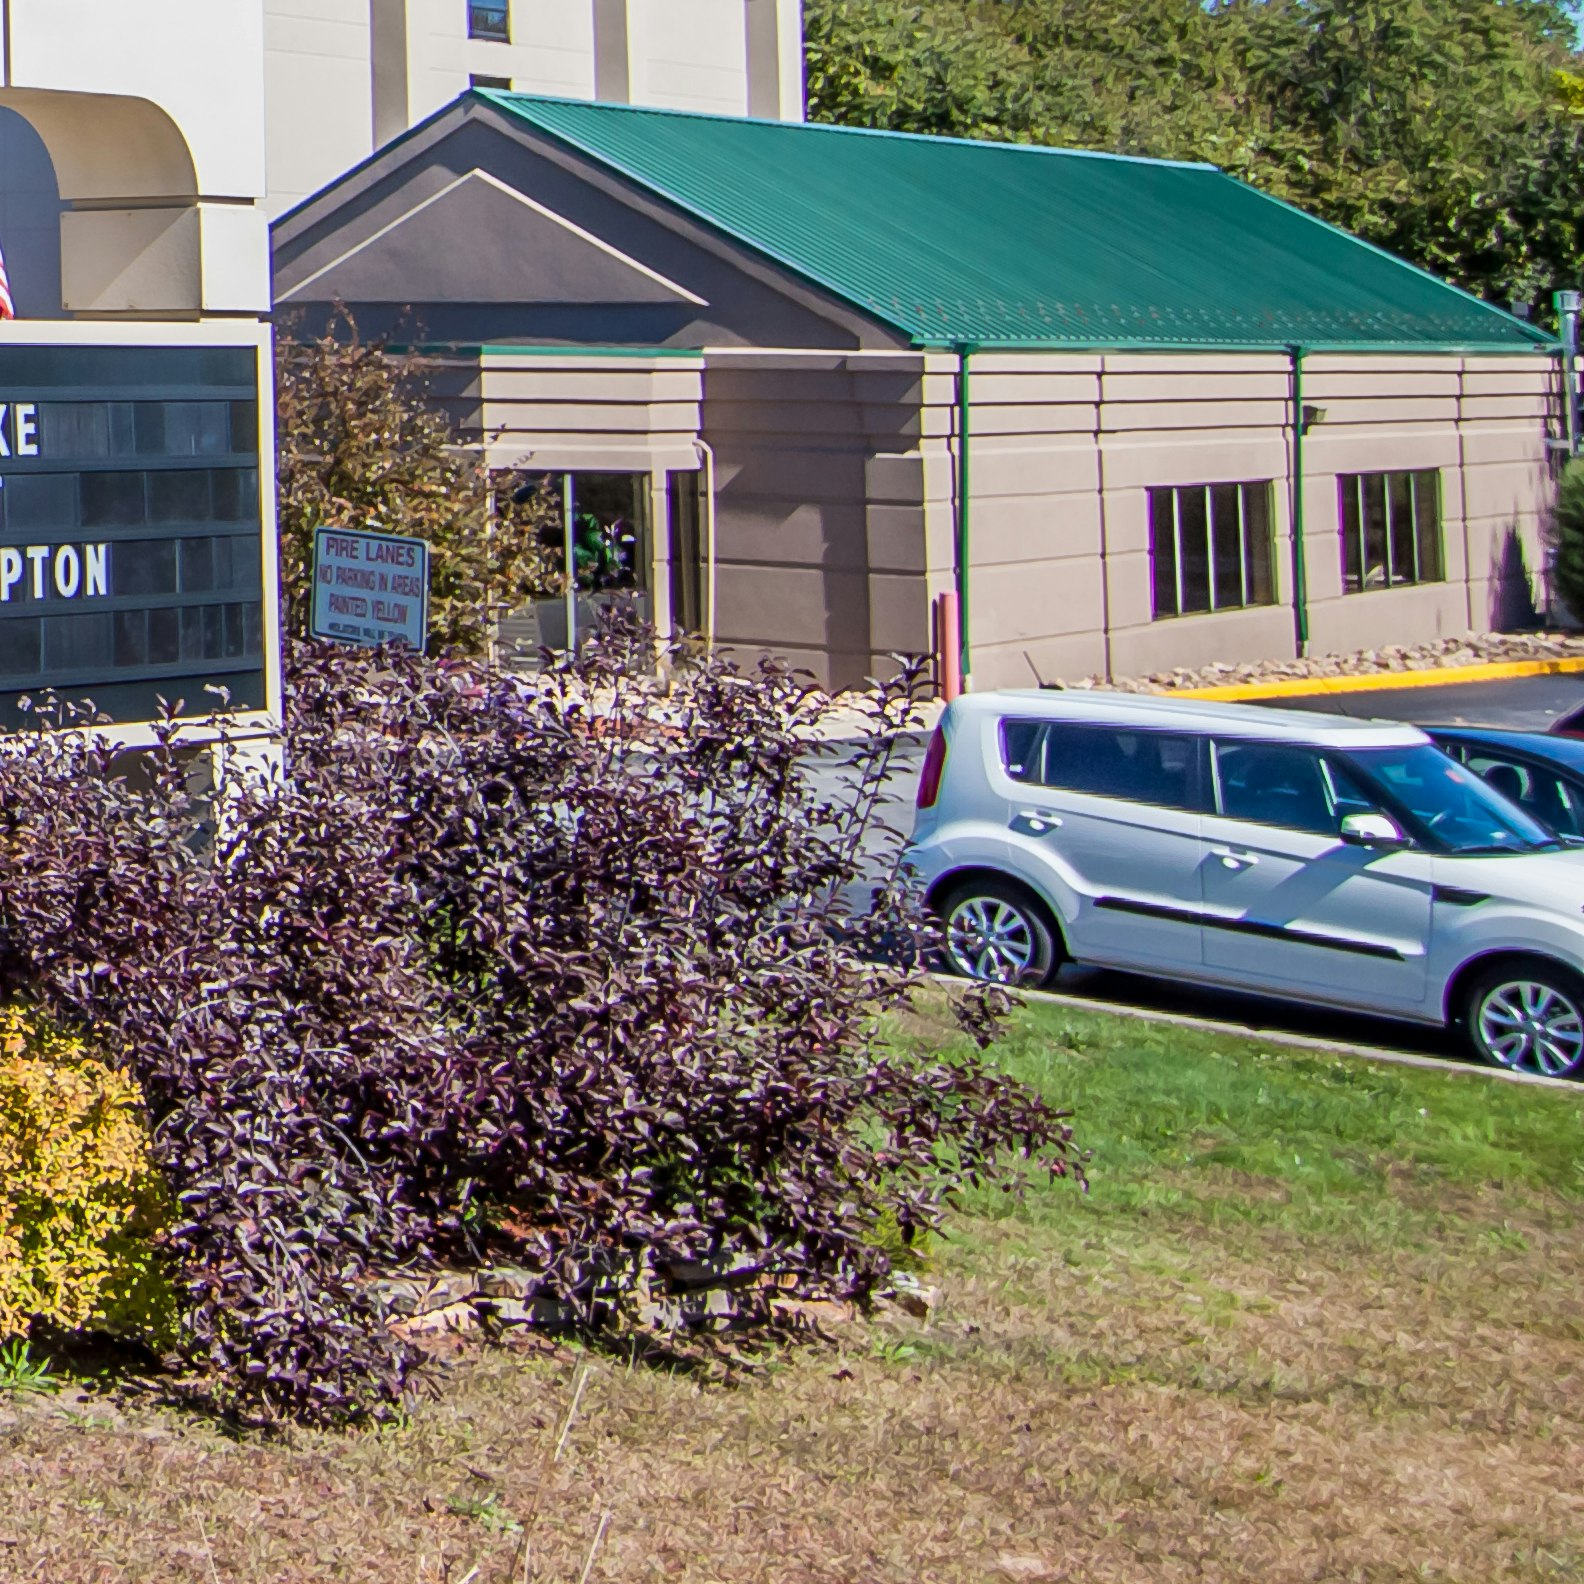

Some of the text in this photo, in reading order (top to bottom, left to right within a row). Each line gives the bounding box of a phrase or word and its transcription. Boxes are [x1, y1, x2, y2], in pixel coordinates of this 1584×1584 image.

[326, 536, 415, 567] FIRE LANES
[319, 564, 420, 598] NO PARKING IN AREAS
[329, 593, 408, 624] PAINTED YELLOW
